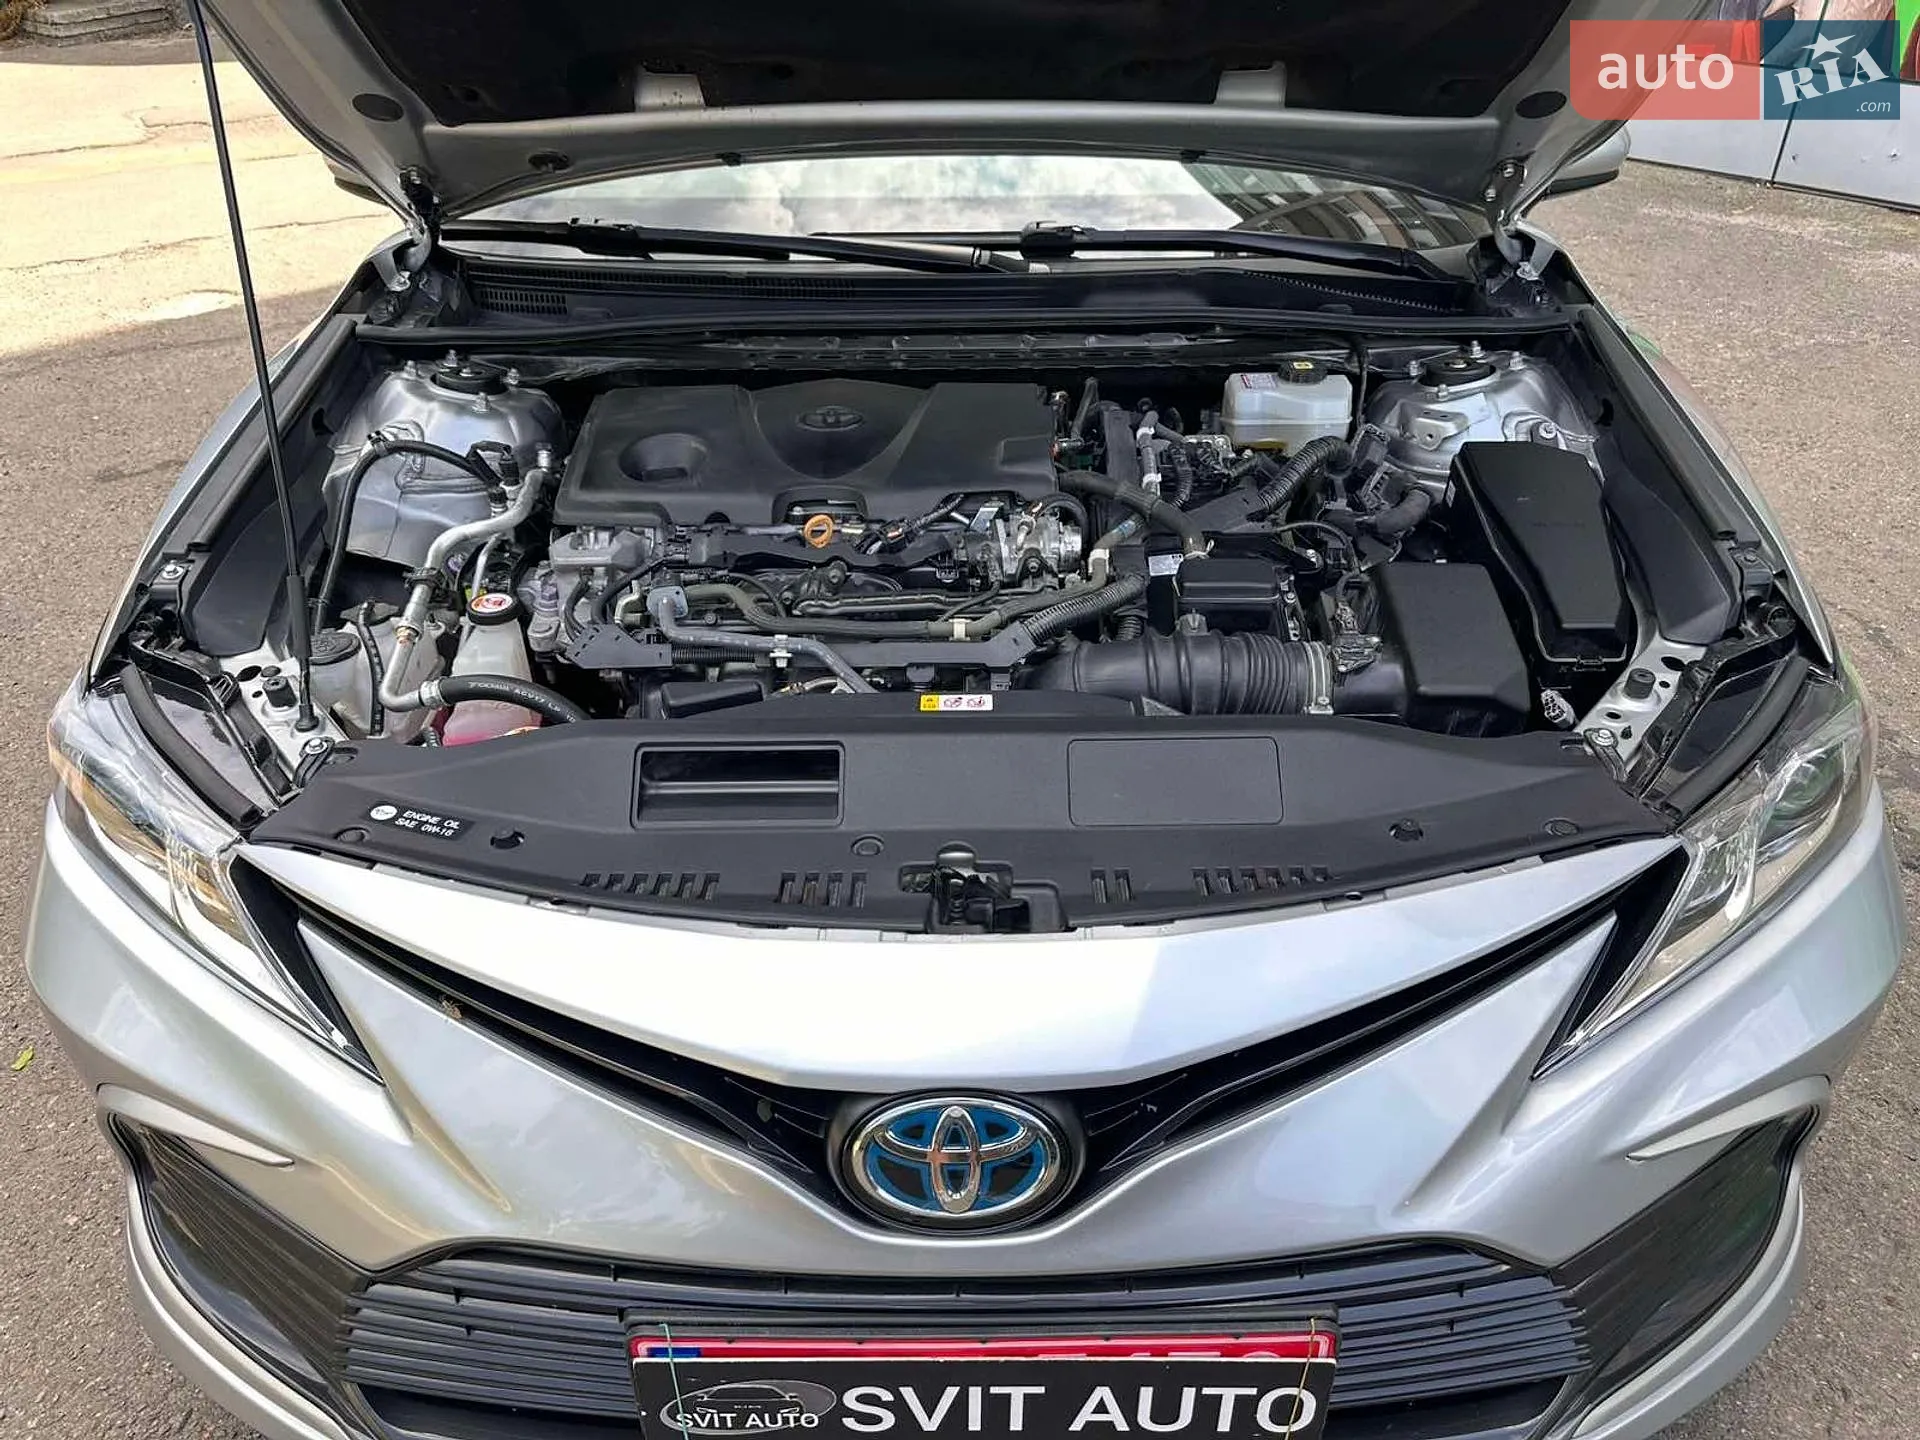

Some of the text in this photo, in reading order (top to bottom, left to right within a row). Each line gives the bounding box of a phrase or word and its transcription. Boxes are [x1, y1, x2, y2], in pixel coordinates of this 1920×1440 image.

[395, 818, 417, 828] SAE
[403, 810, 441, 823] ENGINE
[841, 1385, 1317, 1433] SVIT AUTO
[676, 1413, 819, 1428] SVIT AUTO
